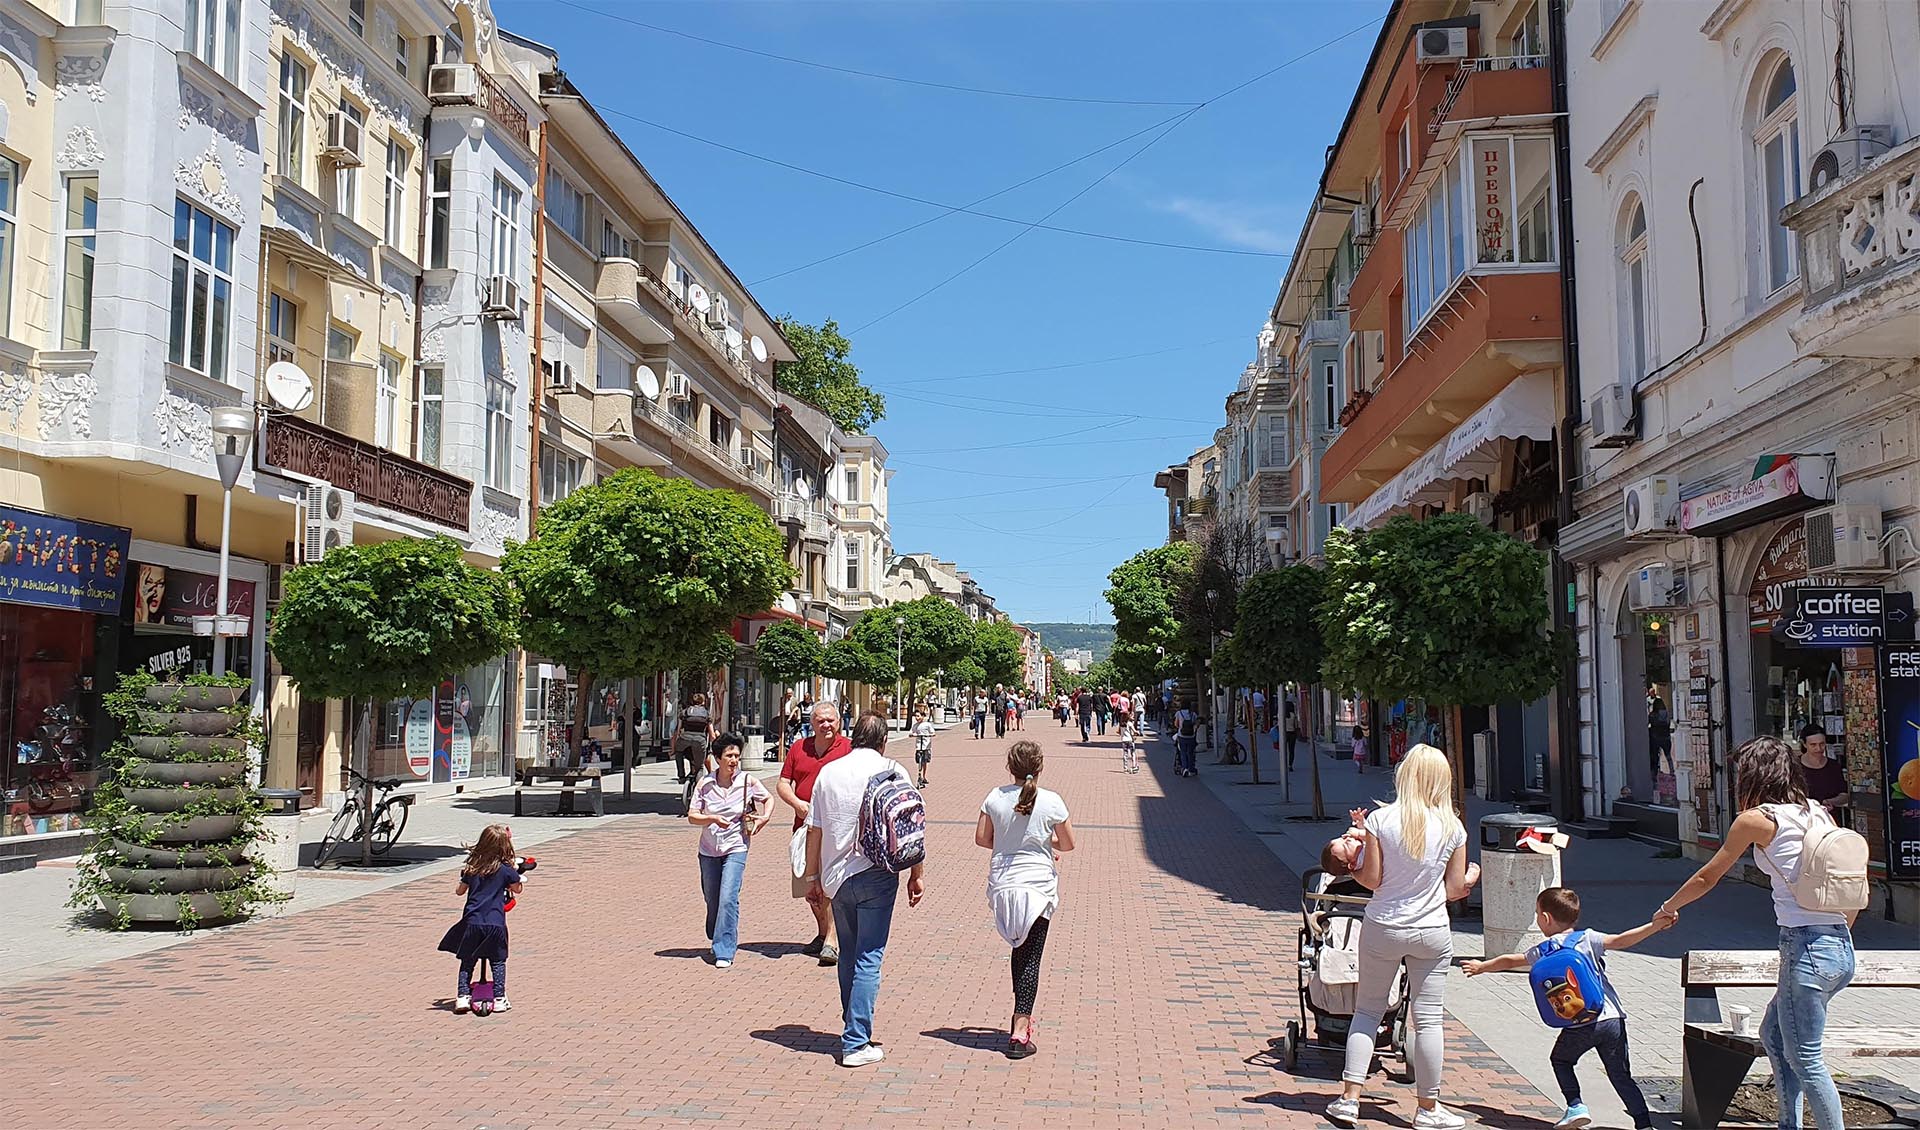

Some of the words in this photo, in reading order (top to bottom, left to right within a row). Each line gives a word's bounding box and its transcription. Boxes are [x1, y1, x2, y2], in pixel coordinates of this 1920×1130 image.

[1484, 151, 1502, 248] ПРЕВОДИ
[1706, 489, 1732, 509] NATURE
[1805, 593, 1881, 614] coffee
[1822, 623, 1882, 637] station
[149, 650, 175, 674] SILVER
[176, 645, 192, 664] 925
[1889, 652, 1920, 664] FRE
[1889, 665, 1920, 677] stat
